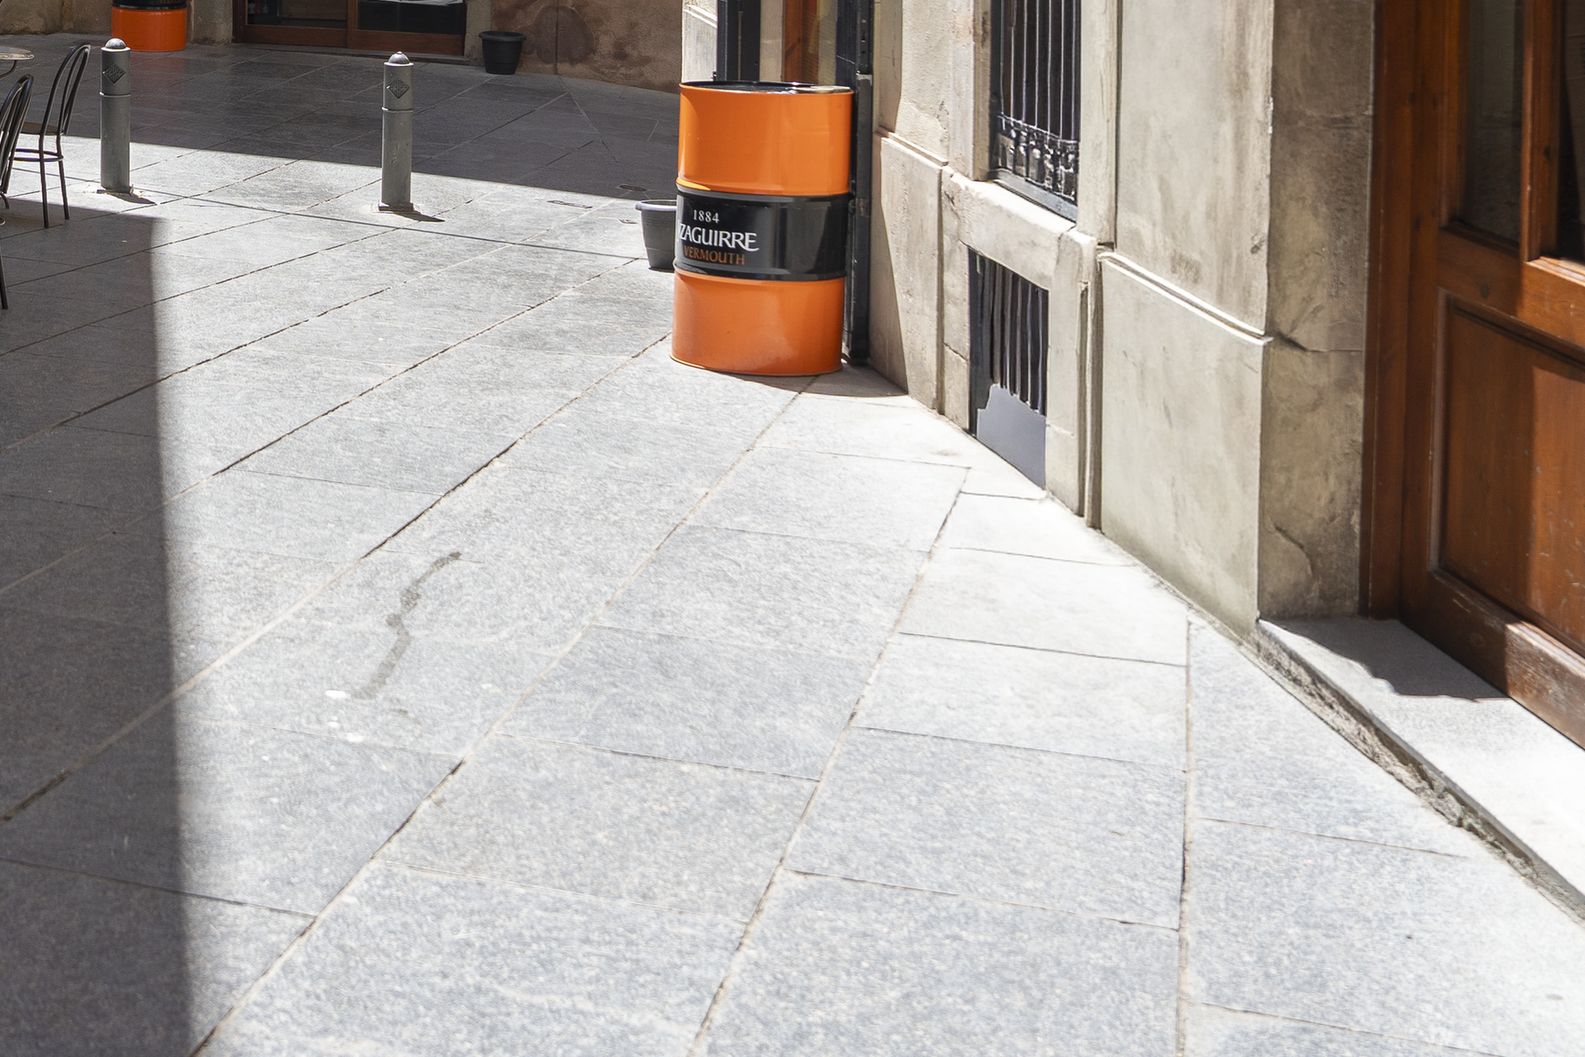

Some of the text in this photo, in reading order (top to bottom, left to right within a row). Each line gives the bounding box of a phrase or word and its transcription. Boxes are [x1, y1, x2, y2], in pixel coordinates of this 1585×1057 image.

[693, 209, 720, 224] 1884
[677, 222, 760, 252] ZAGUIRRE
[683, 245, 746, 265] VERMOUTH
